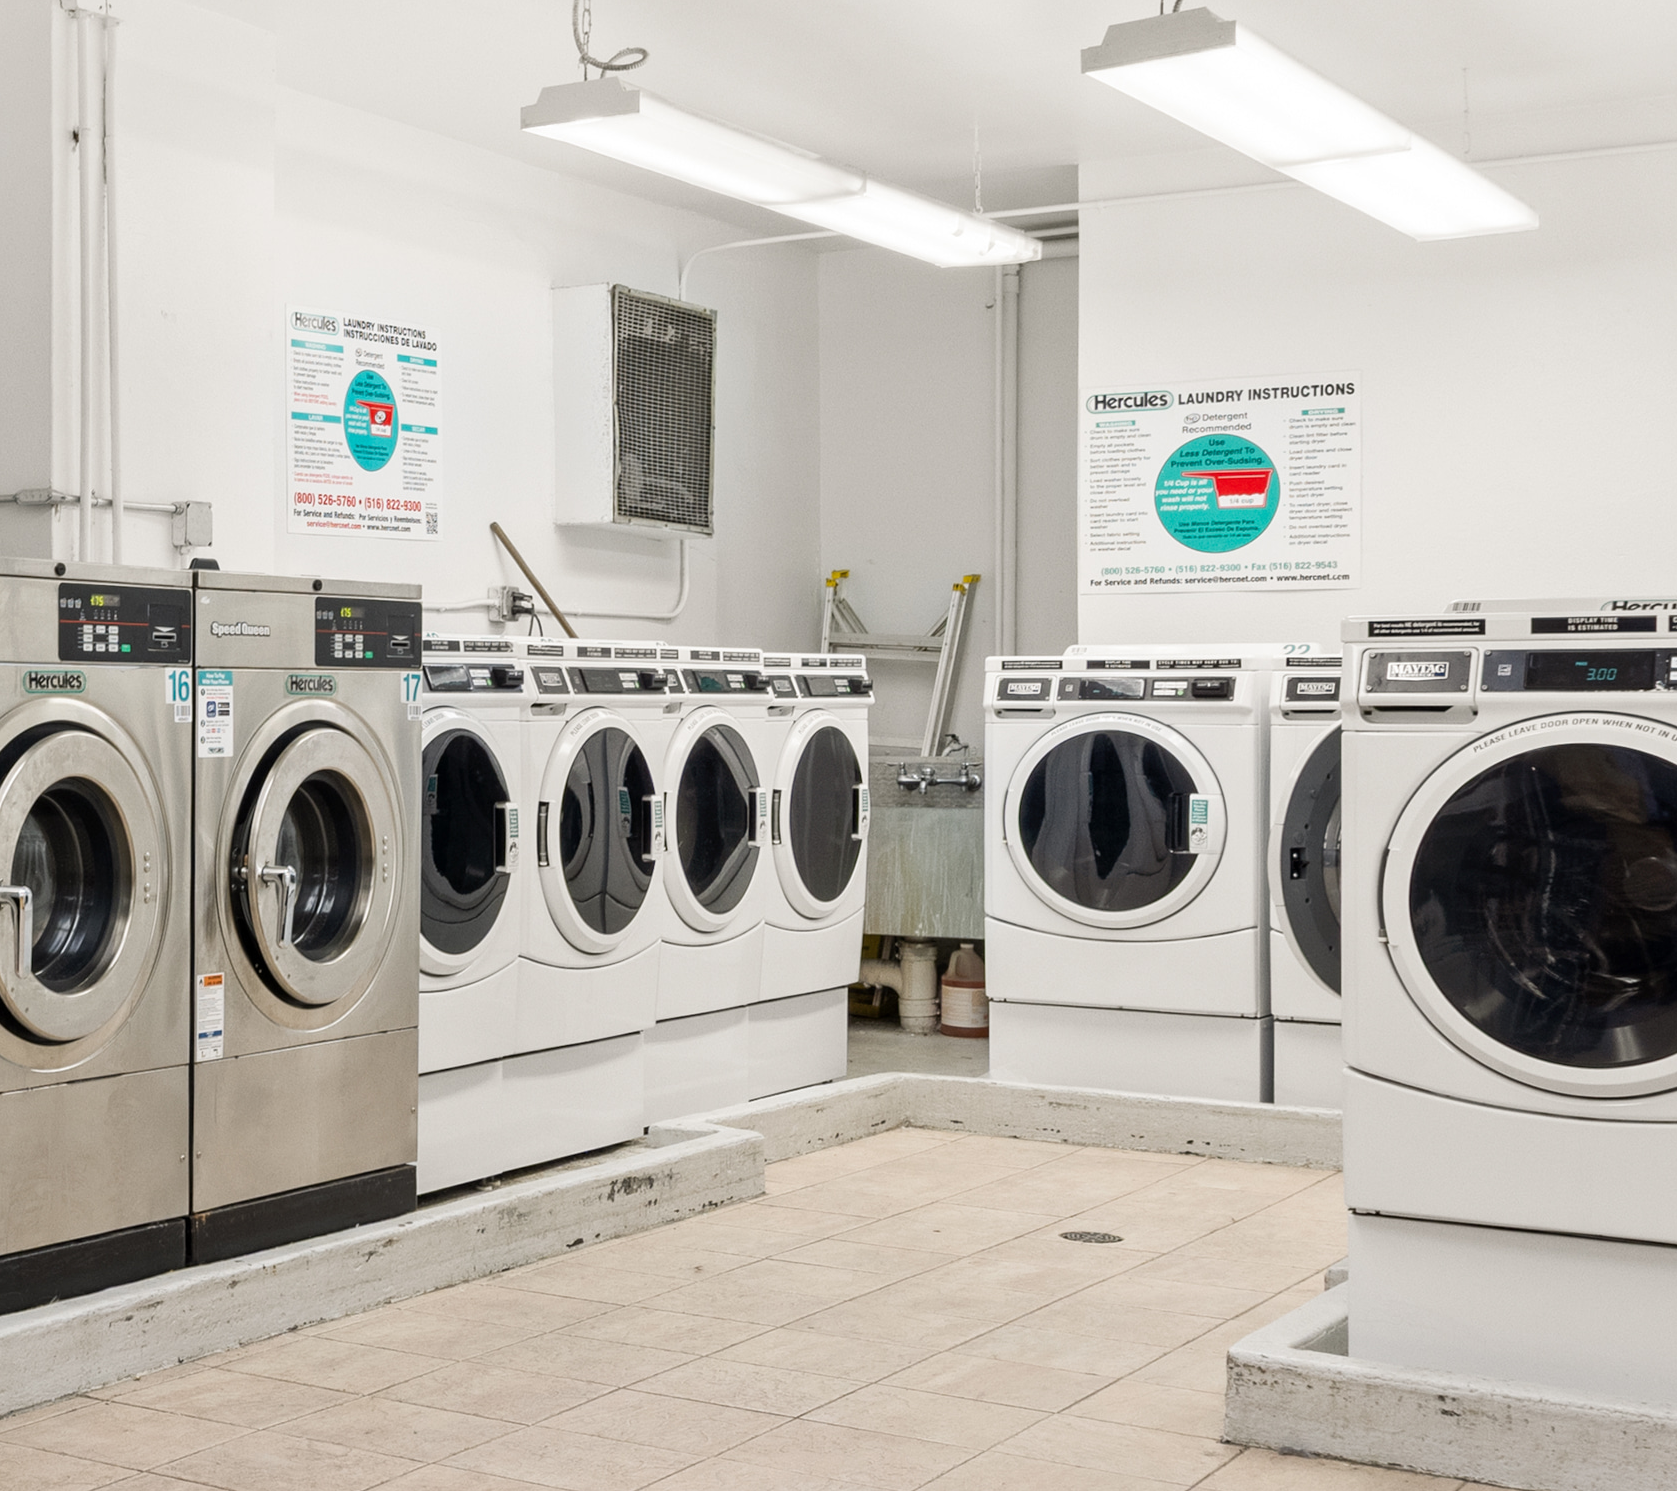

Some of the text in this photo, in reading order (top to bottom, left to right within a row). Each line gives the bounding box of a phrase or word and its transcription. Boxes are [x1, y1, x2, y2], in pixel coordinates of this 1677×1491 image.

[294, 312, 336, 332] Hercules
[343, 318, 426, 339] LAUNDRY INSTRUCTIONS
[344, 328, 437, 351] INSTRUCCIONES DE LAVADO
[1094, 392, 1168, 410] Hercules
[1178, 382, 1355, 405] LAUNDRY INSTRUCTIONS
[1202, 412, 1248, 424] Detergent
[1182, 422, 1252, 434] Recommended
[294, 492, 315, 507] (800)
[318, 493, 356, 508] 526-5760
[364, 498, 384, 512] (516)
[386, 499, 422, 512] 822-9300
[1101, 561, 1338, 576] (800) 526-5760 (516) 822-9300 Fax (516) 822-9543
[211, 622, 271, 638] Speed Queen
[1390, 663, 1445, 675] MAYTAG
[1586, 669, 1617, 681] 3.00
[29, 672, 82, 689] Hercules
[168, 670, 190, 702] 16
[290, 676, 334, 692] Hercules
[403, 674, 421, 702] 17
